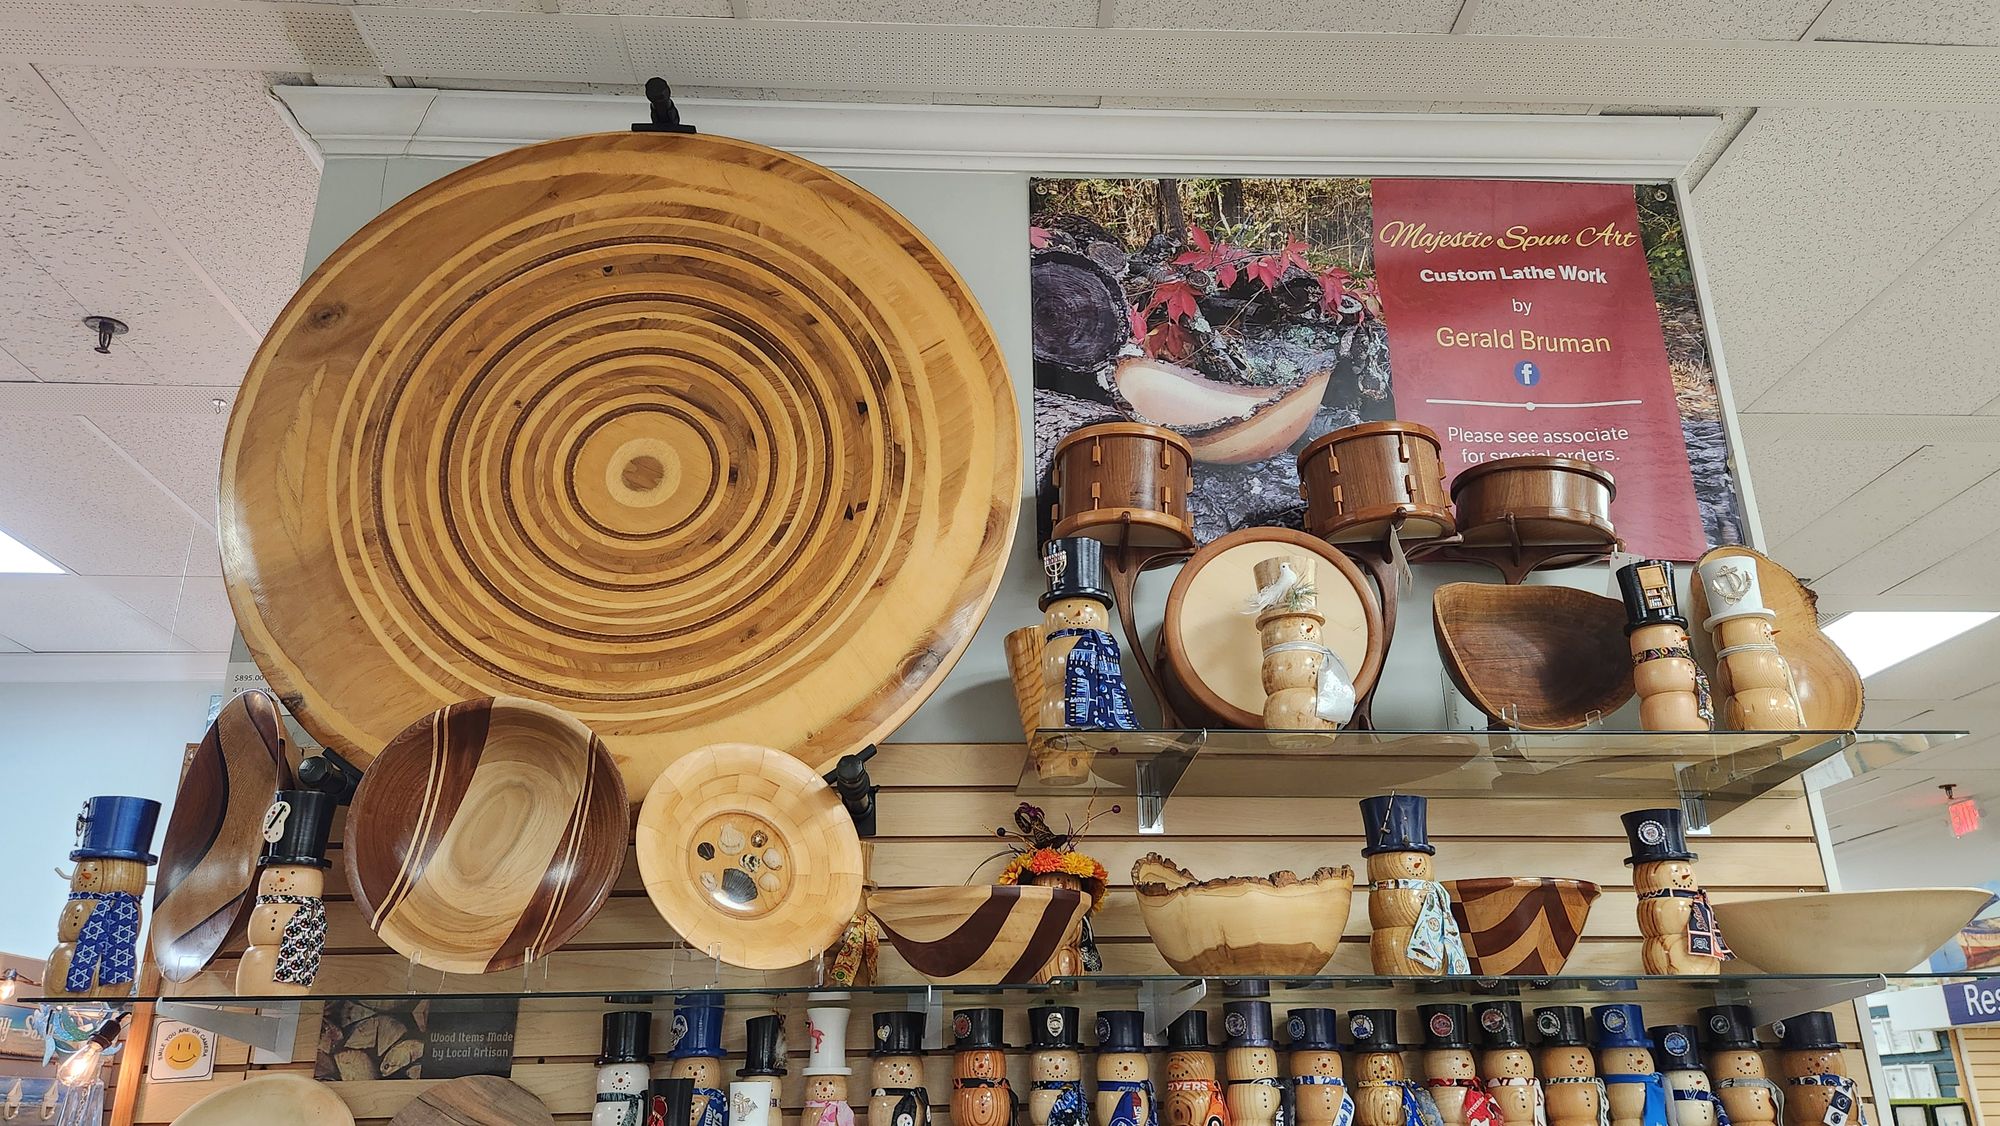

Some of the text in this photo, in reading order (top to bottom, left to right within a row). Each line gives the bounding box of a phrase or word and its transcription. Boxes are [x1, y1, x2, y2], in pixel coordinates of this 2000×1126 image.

[1379, 220, 1638, 253] Majestic Spun Art
[1420, 265, 1608, 284] Custom Lathe Work
[1512, 298, 1532, 316] by
[1436, 326, 1611, 353] Gerald Bruman
[1448, 426, 1629, 443] Please see associate
[1461, 449, 1485, 463] for
[165, 1031, 177, 1042] YOU
[430, 1031, 514, 1042] Wood Items Made
[432, 1046, 509, 1060] by Local Artisan
